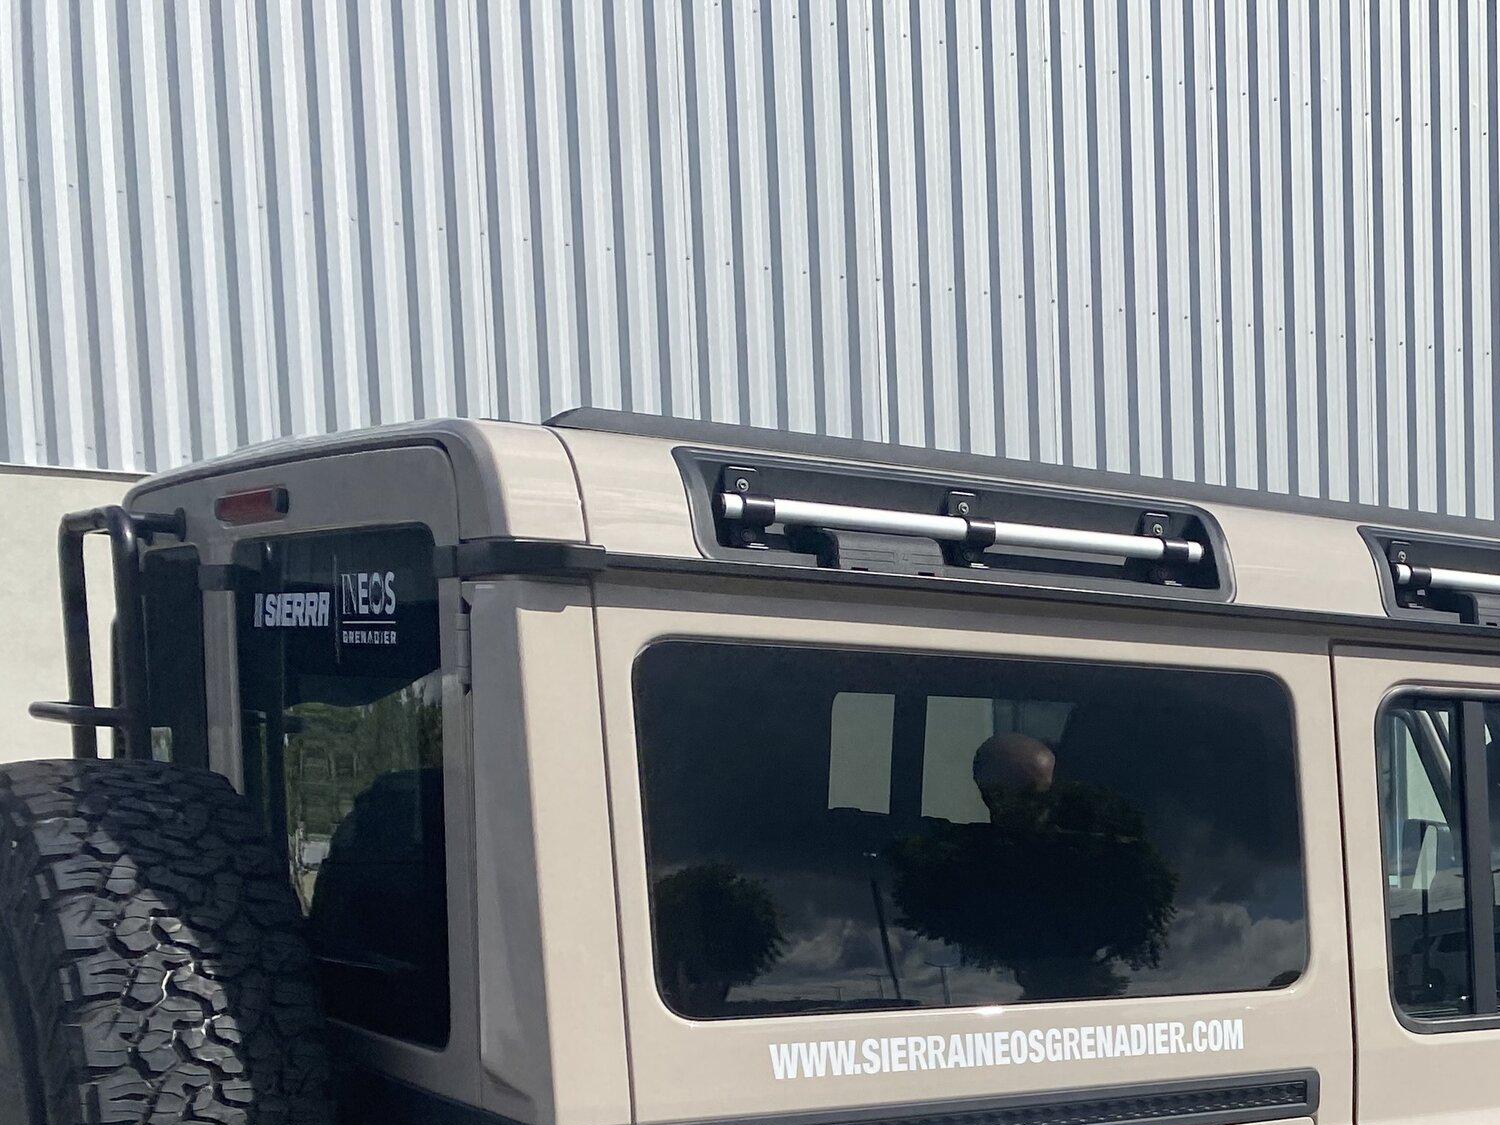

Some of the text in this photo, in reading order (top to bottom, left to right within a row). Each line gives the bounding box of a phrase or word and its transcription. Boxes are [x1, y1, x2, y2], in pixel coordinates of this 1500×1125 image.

[265, 592, 330, 627] SIERRA
[342, 630, 397, 645] GRENADIER
[769, 1019, 1244, 1080] WWW.SIERRAINEOSGRENADIER.COM
